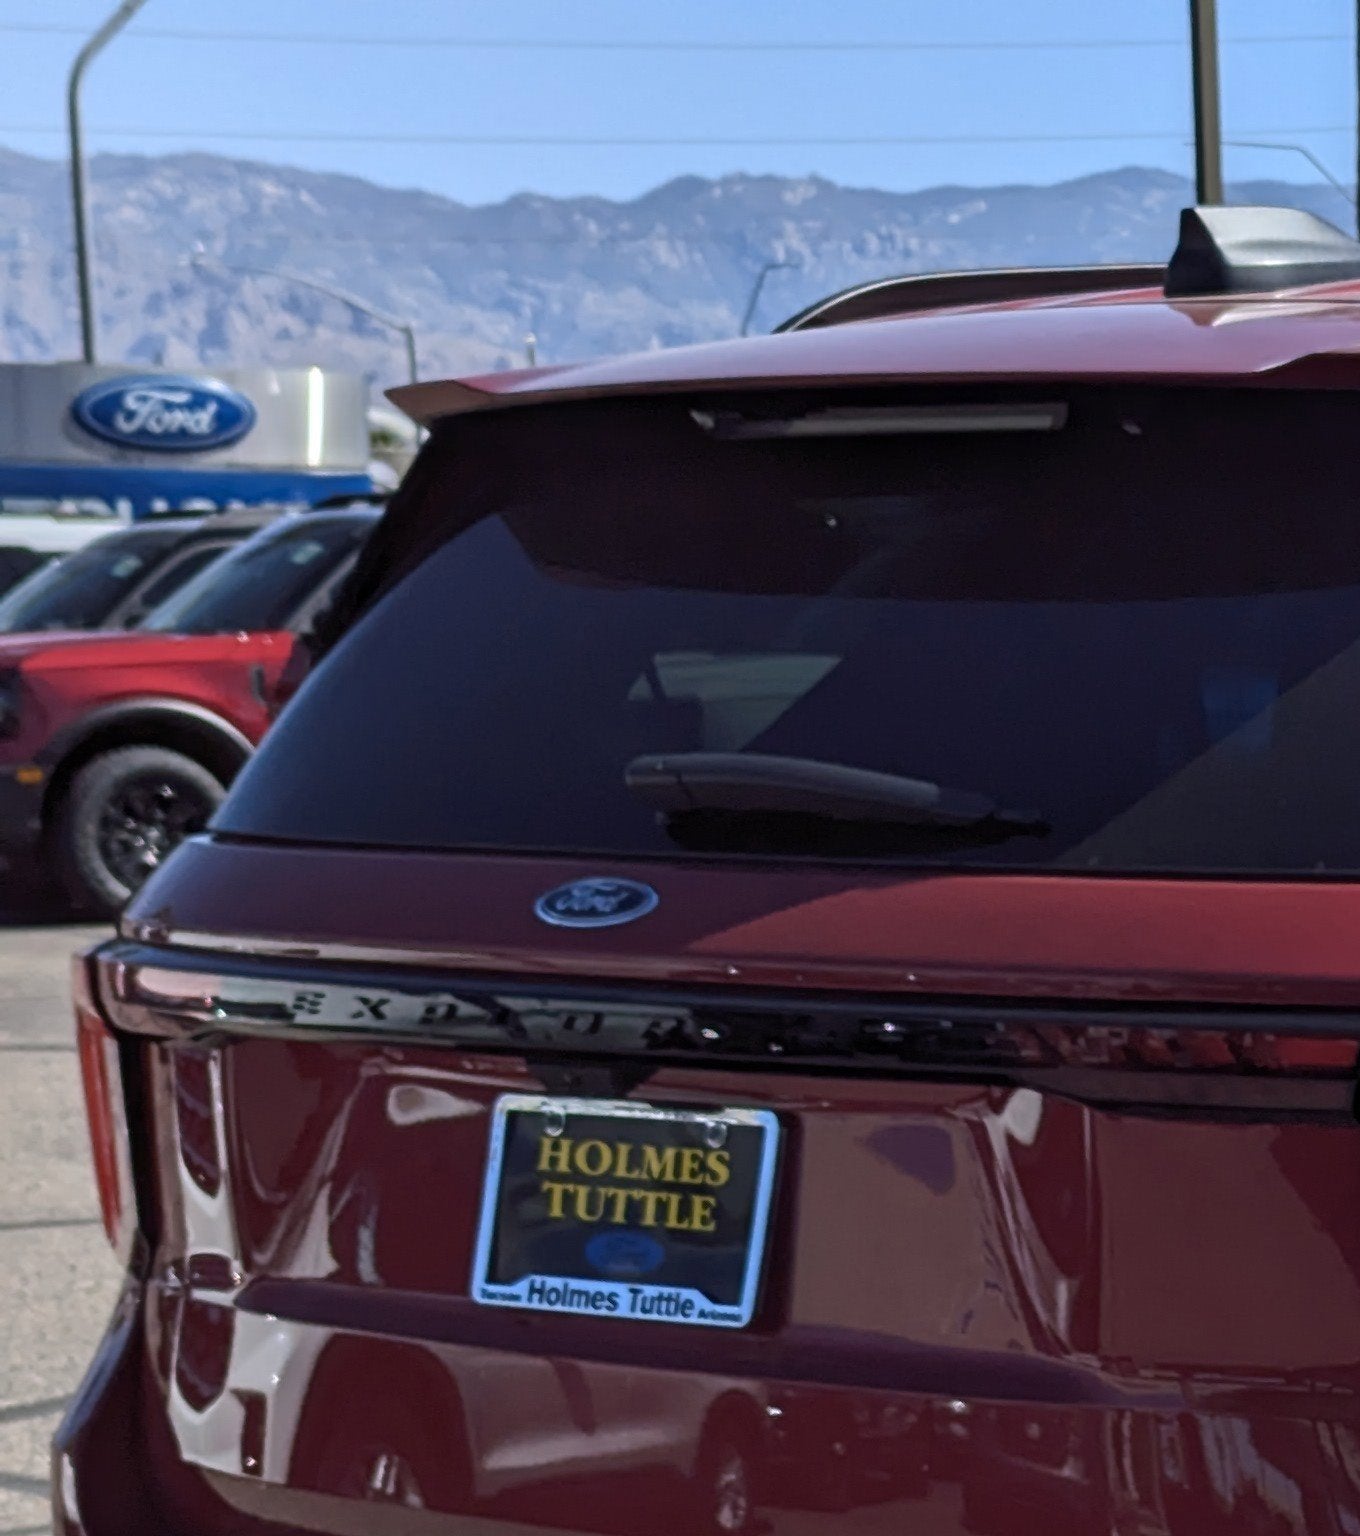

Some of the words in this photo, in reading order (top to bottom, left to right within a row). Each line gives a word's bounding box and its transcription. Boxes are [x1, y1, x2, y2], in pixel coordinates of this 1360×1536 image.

[114, 389, 218, 434] Ford
[537, 1136, 731, 1188] HOLMES
[540, 1178, 717, 1232] TUTTLE
[526, 1278, 620, 1312] Holmes
[628, 1286, 696, 1319] Tuttle
